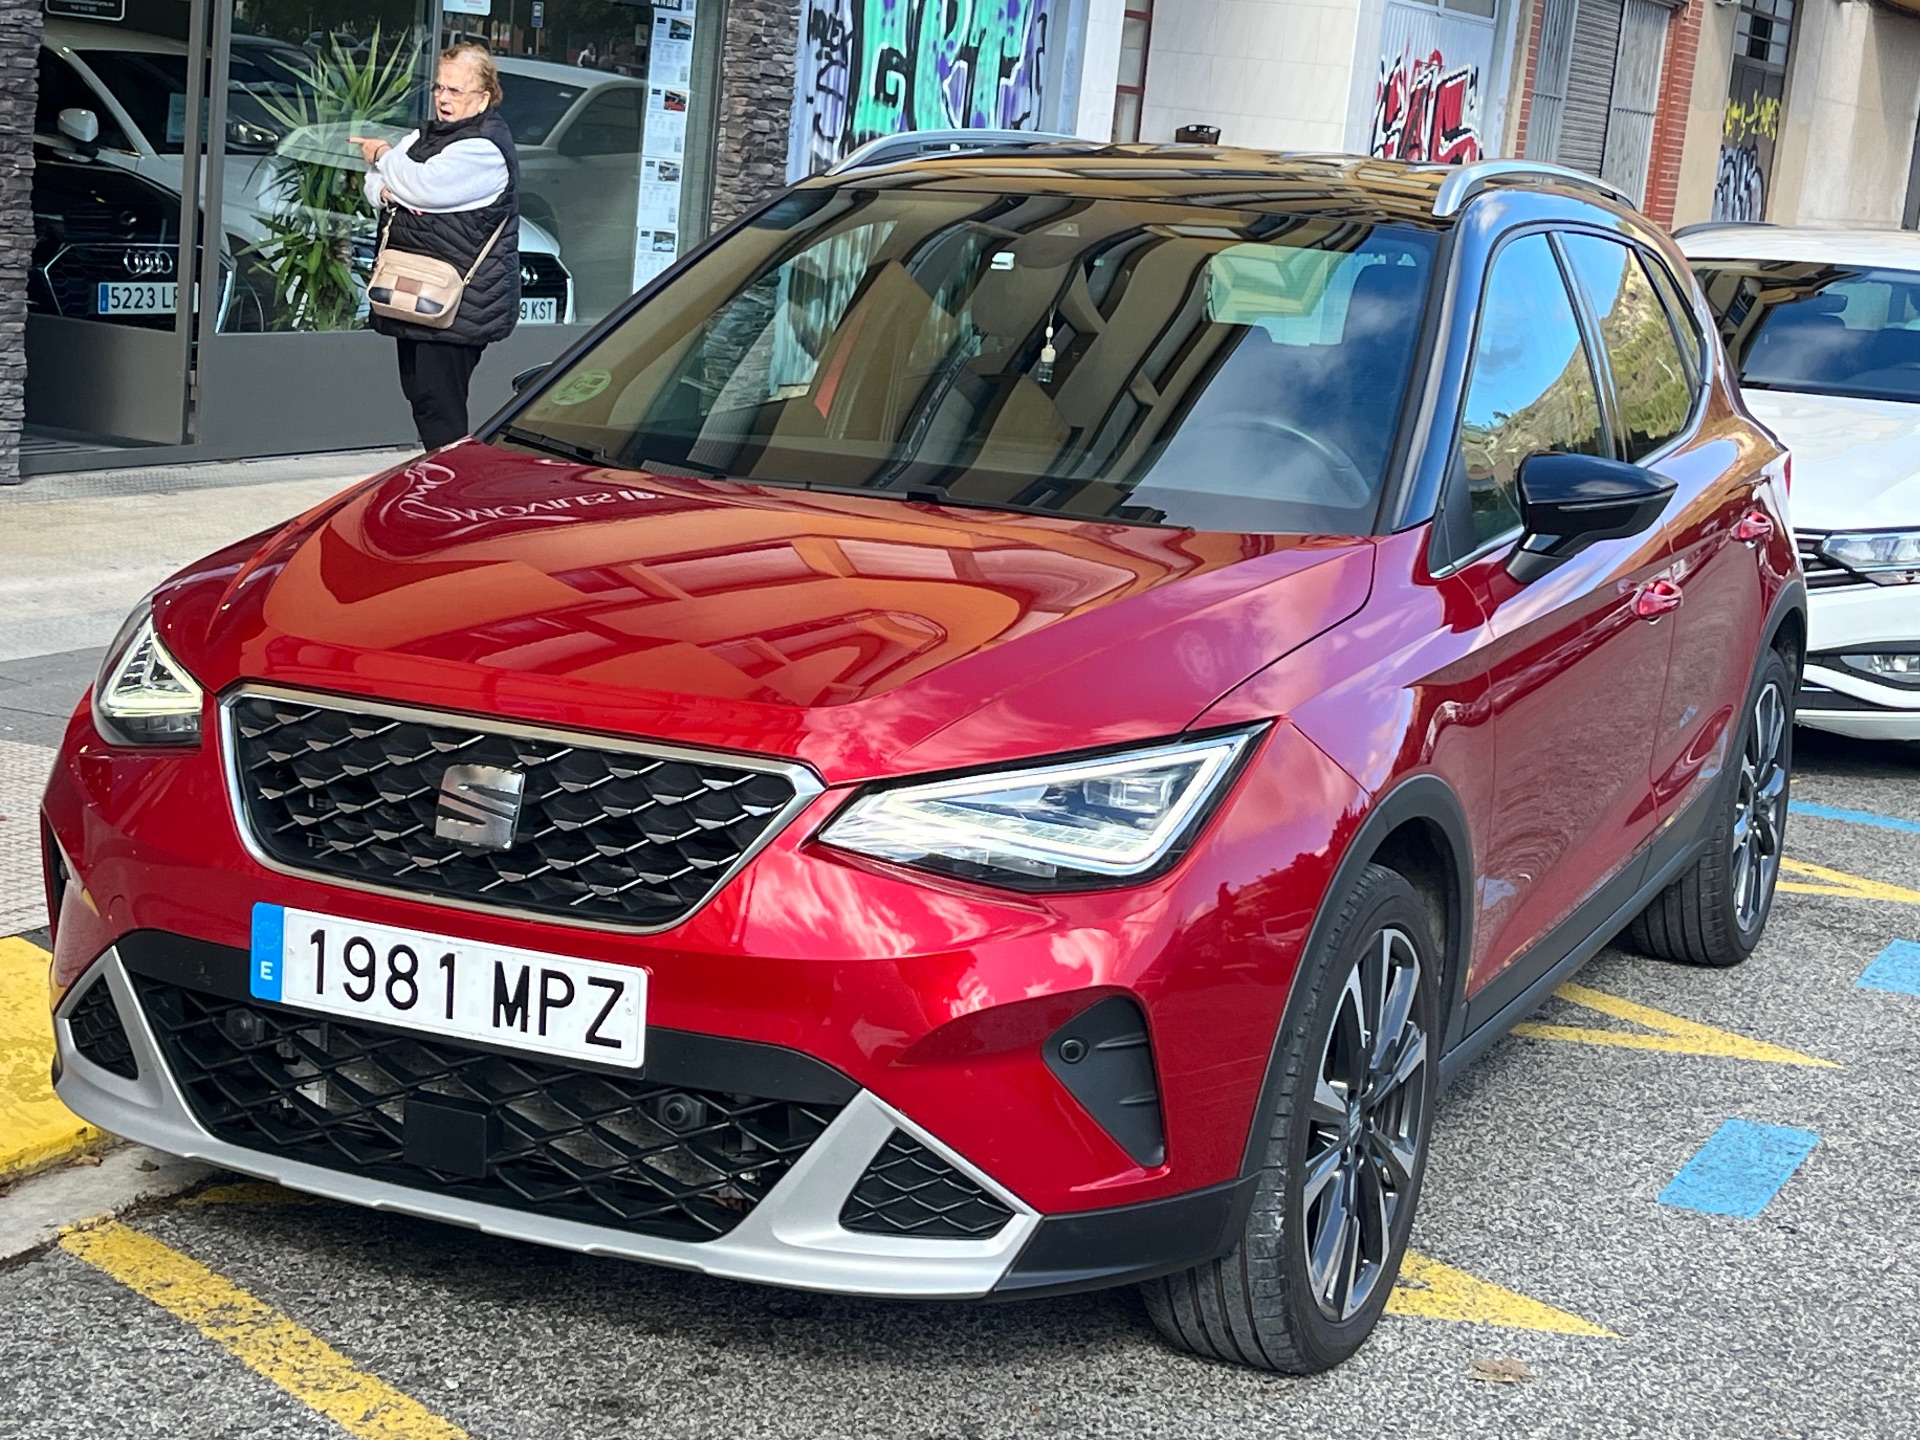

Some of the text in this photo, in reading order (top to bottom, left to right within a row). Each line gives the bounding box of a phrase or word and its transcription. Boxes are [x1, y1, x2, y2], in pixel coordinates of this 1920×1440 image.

[110, 286, 156, 309] 5223
[531, 301, 553, 320] KST
[260, 961, 273, 980] E
[310, 928, 625, 1049] 1981 MPZ
